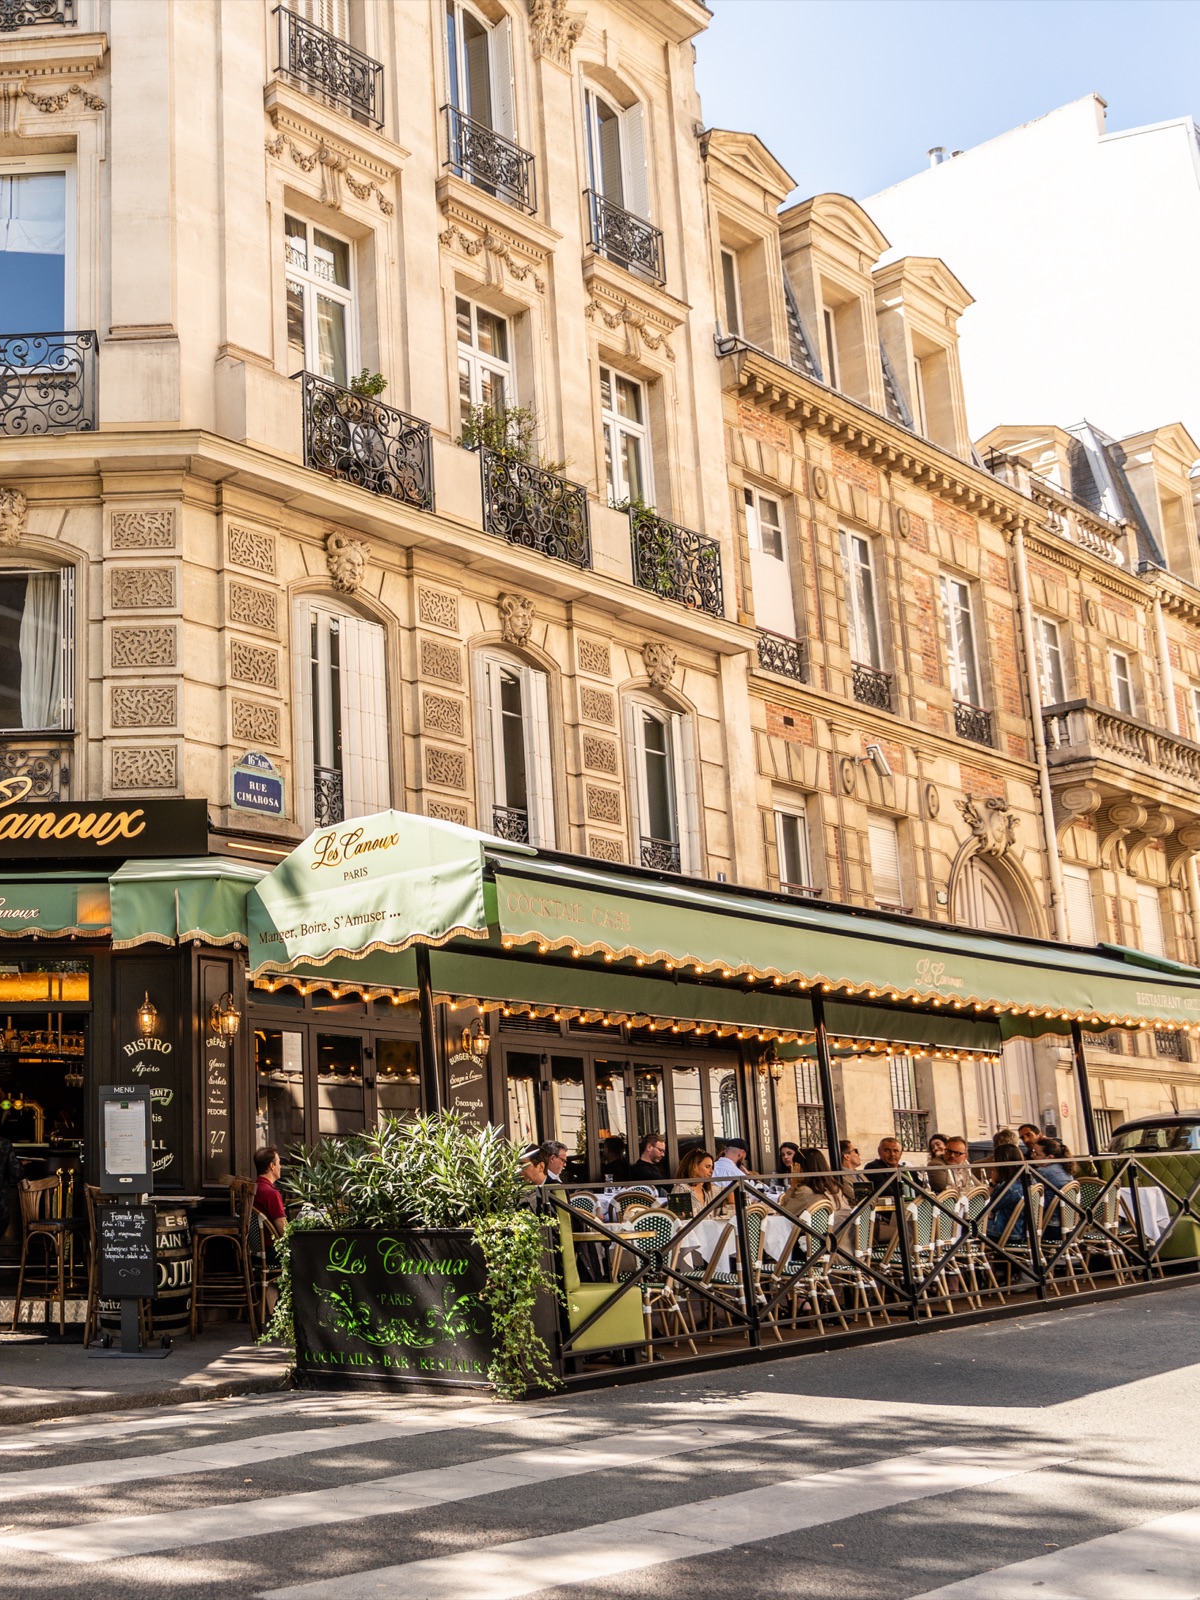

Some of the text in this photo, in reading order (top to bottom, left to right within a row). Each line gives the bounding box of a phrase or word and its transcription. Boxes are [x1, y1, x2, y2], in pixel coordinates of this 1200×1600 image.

[249, 780, 268, 793] RUE
[236, 791, 280, 808] CIMAROSA
[310, 827, 400, 870] Les Canoux
[343, 867, 368, 881] PARIS
[506, 892, 586, 923] COCKTAIL
[258, 928, 298, 945] Manger,
[300, 920, 331, 937] Boire,
[1136, 991, 1182, 1009] RESTAURANT
[123, 1037, 173, 1057] BISTRO
[132, 1061, 161, 1077] Apéro
[208, 1058, 226, 1072] Glaces
[208, 1075, 227, 1085] Sorbets
[449, 1073, 465, 1085] Soupe
[455, 1096, 484, 1110] Escargots
[152, 1112, 163, 1122] tis
[207, 1108, 228, 1116] PEDONE
[759, 1075, 771, 1153] HAPPY HOUR
[152, 1140, 167, 1150] LL
[210, 1130, 226, 1145] 7/7
[211, 1146, 223, 1158] jours
[325, 1237, 469, 1275] Les Canoux
[304, 1351, 375, 1366] COCKTAILS
[383, 1354, 410, 1369] BAR
